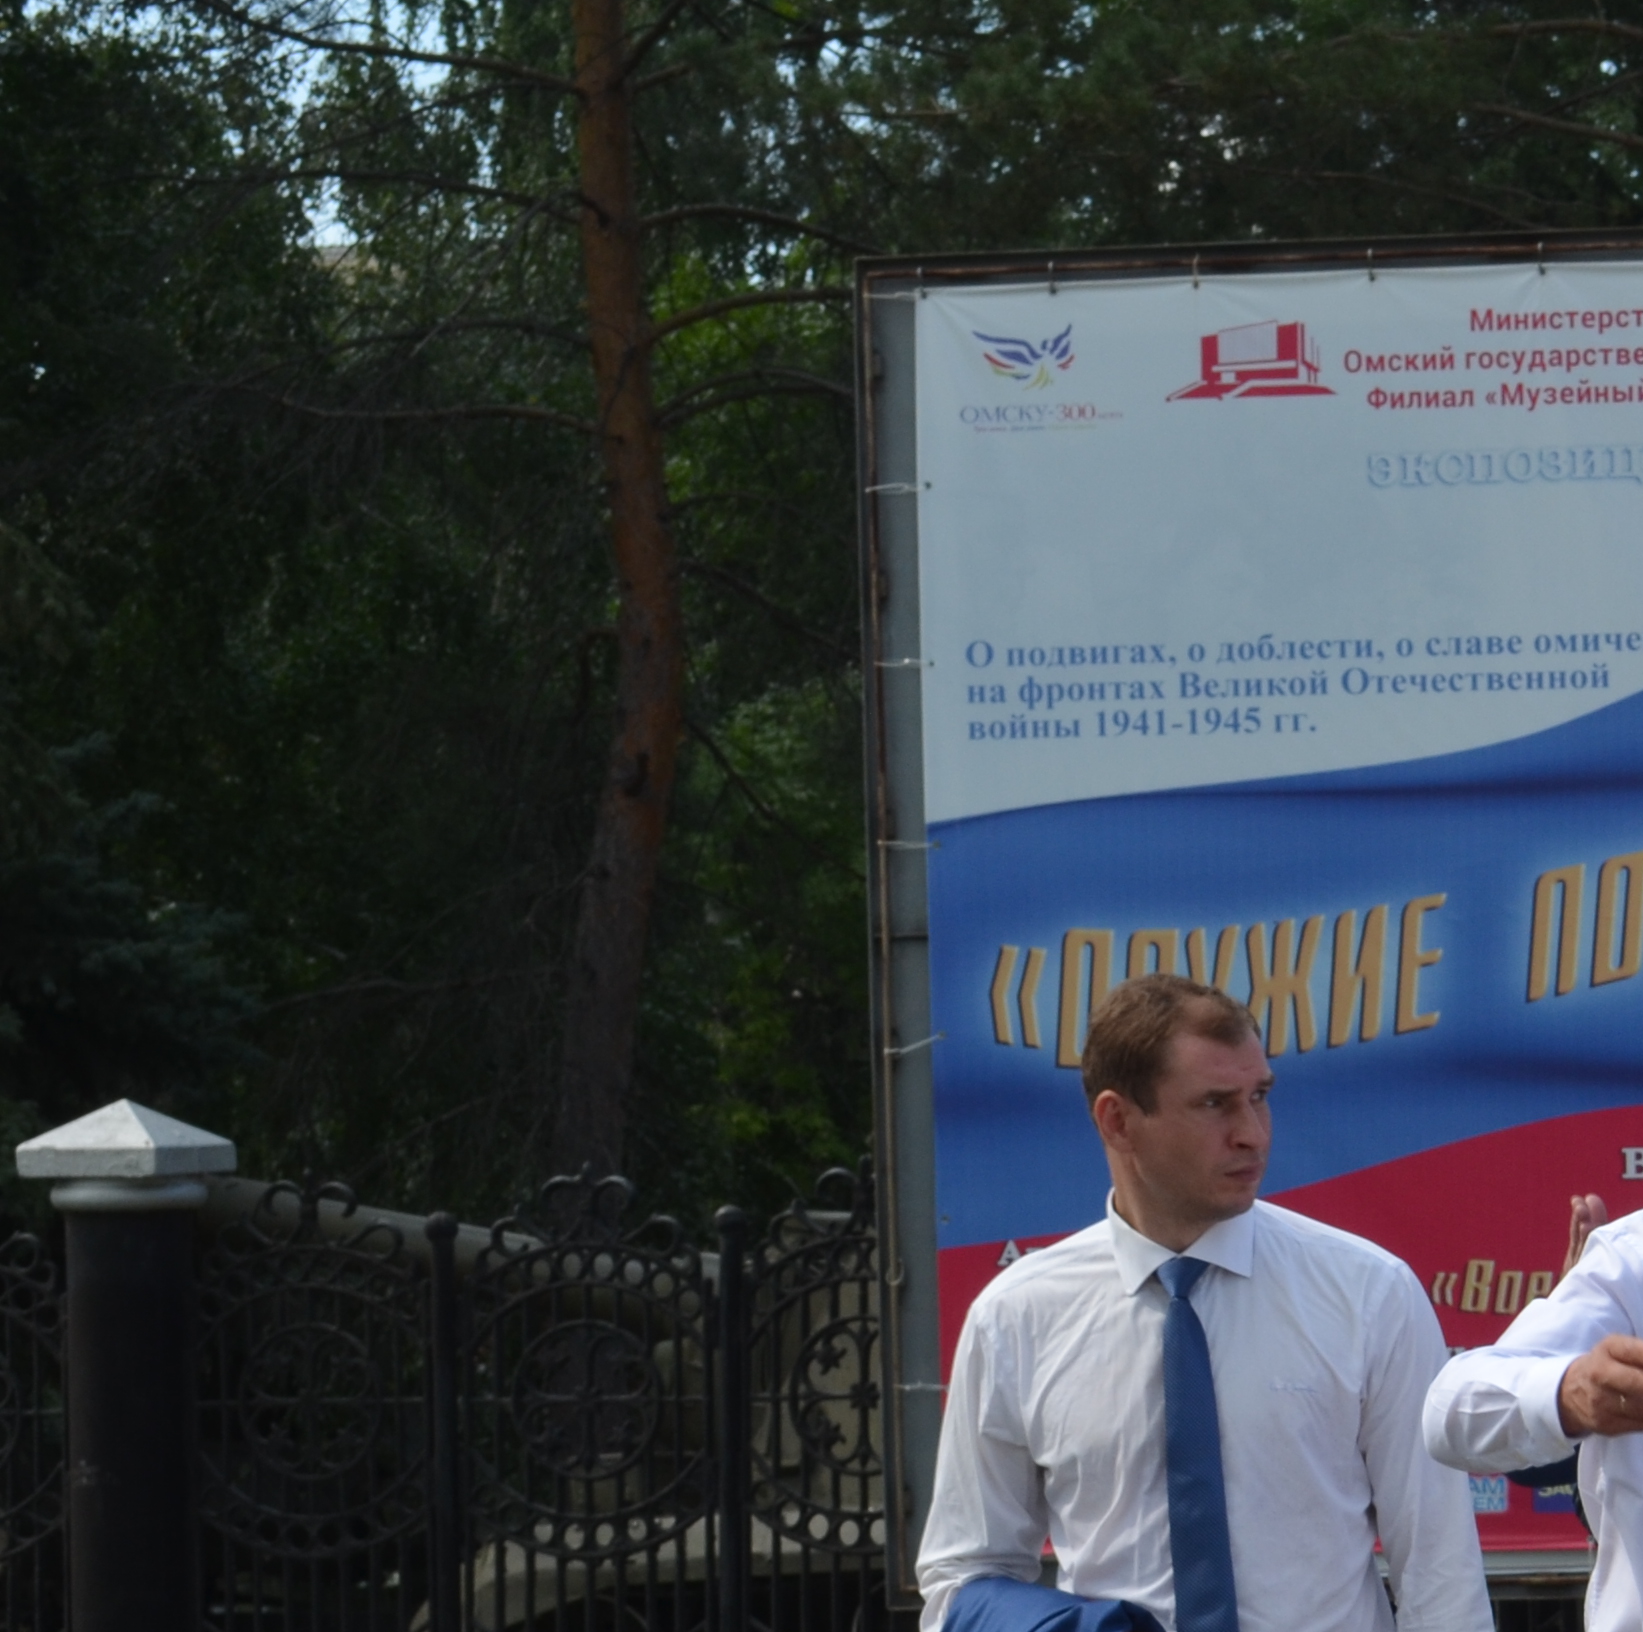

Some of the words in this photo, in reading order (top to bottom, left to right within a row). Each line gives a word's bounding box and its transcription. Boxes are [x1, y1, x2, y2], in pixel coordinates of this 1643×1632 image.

[1343, 346, 1455, 373] Омский
[1367, 387, 1475, 409] Филиал
[965, 639, 994, 667] О
[1007, 642, 1176, 668] подвигах,
[1187, 642, 1206, 663] о
[1216, 634, 1385, 664] доблести,
[1395, 636, 1414, 659] о
[1425, 632, 1523, 658] славе
[967, 682, 1007, 704] на
[1018, 676, 1166, 710] фронтах
[1179, 670, 1329, 699] Великой
[1341, 663, 1610, 696] Отечественной
[968, 714, 1081, 740] войны
[1096, 706, 1262, 736] 1941-1945
[1273, 712, 1317, 733] гг.
